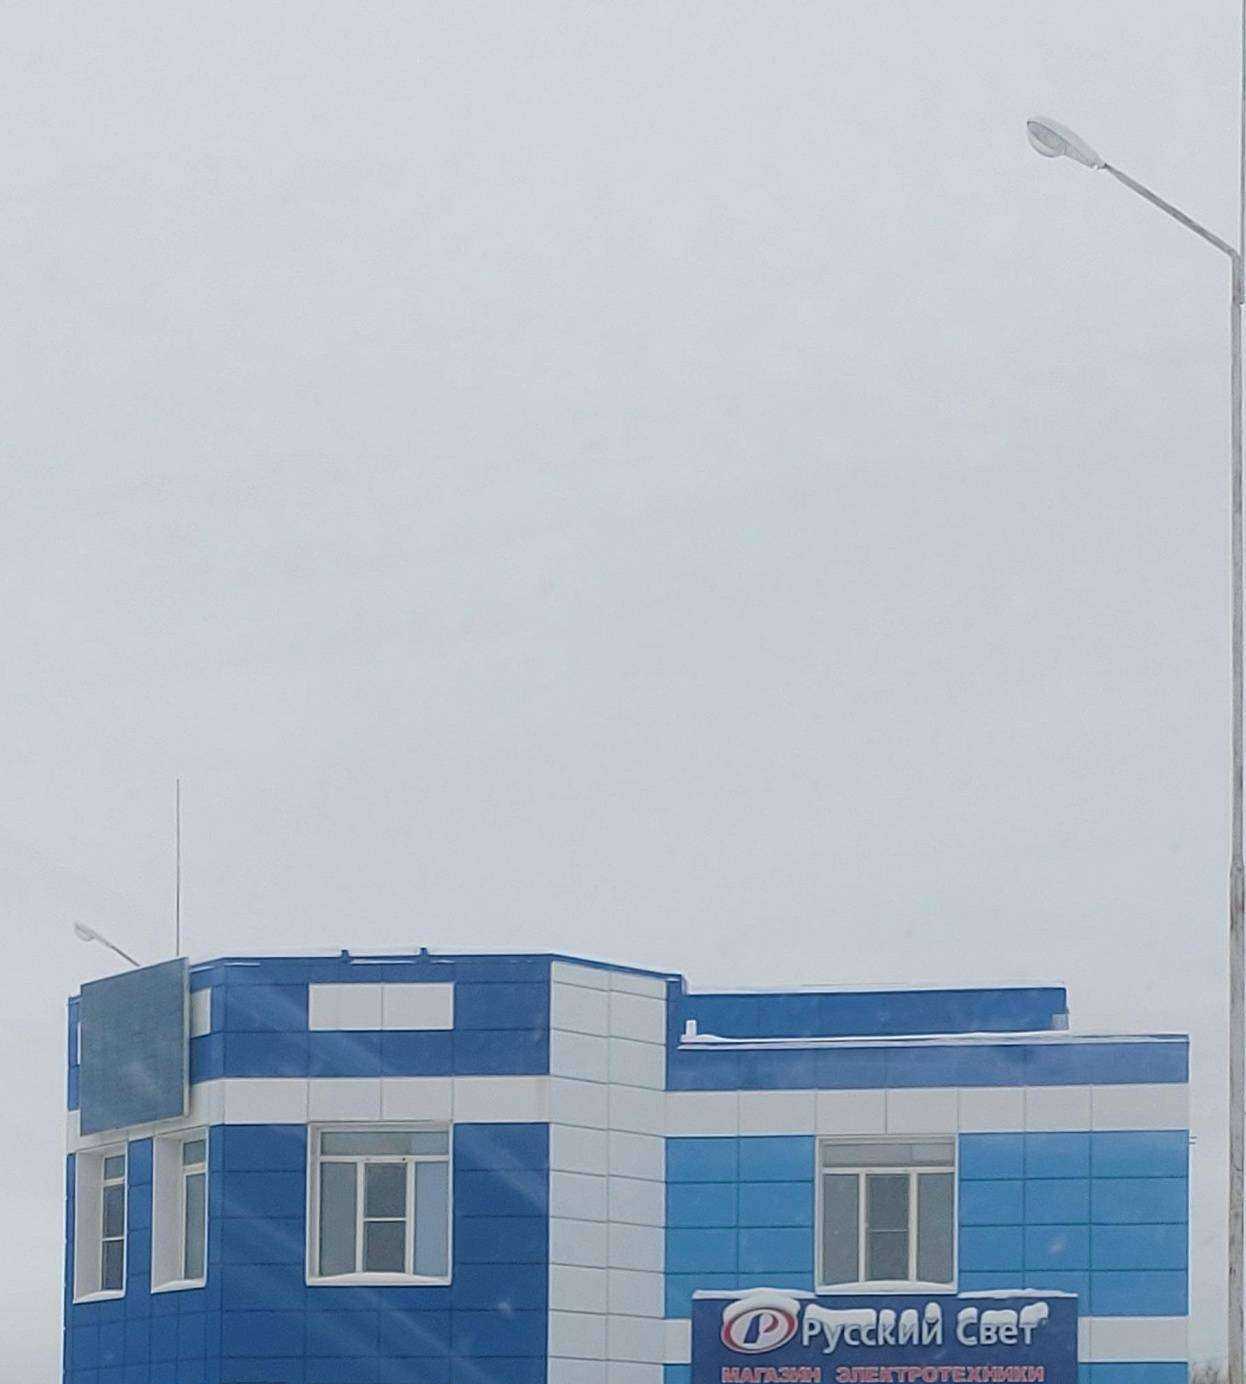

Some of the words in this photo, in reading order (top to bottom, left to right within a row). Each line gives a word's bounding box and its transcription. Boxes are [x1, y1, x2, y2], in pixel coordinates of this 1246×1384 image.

[802, 1306, 943, 1354] Русский
[957, 1309, 1037, 1346] Свет
[721, 1366, 821, 1384] МАГАЗИН
[836, 1365, 1045, 1384] ЭЛЕКТРОТЕХНИКИ
